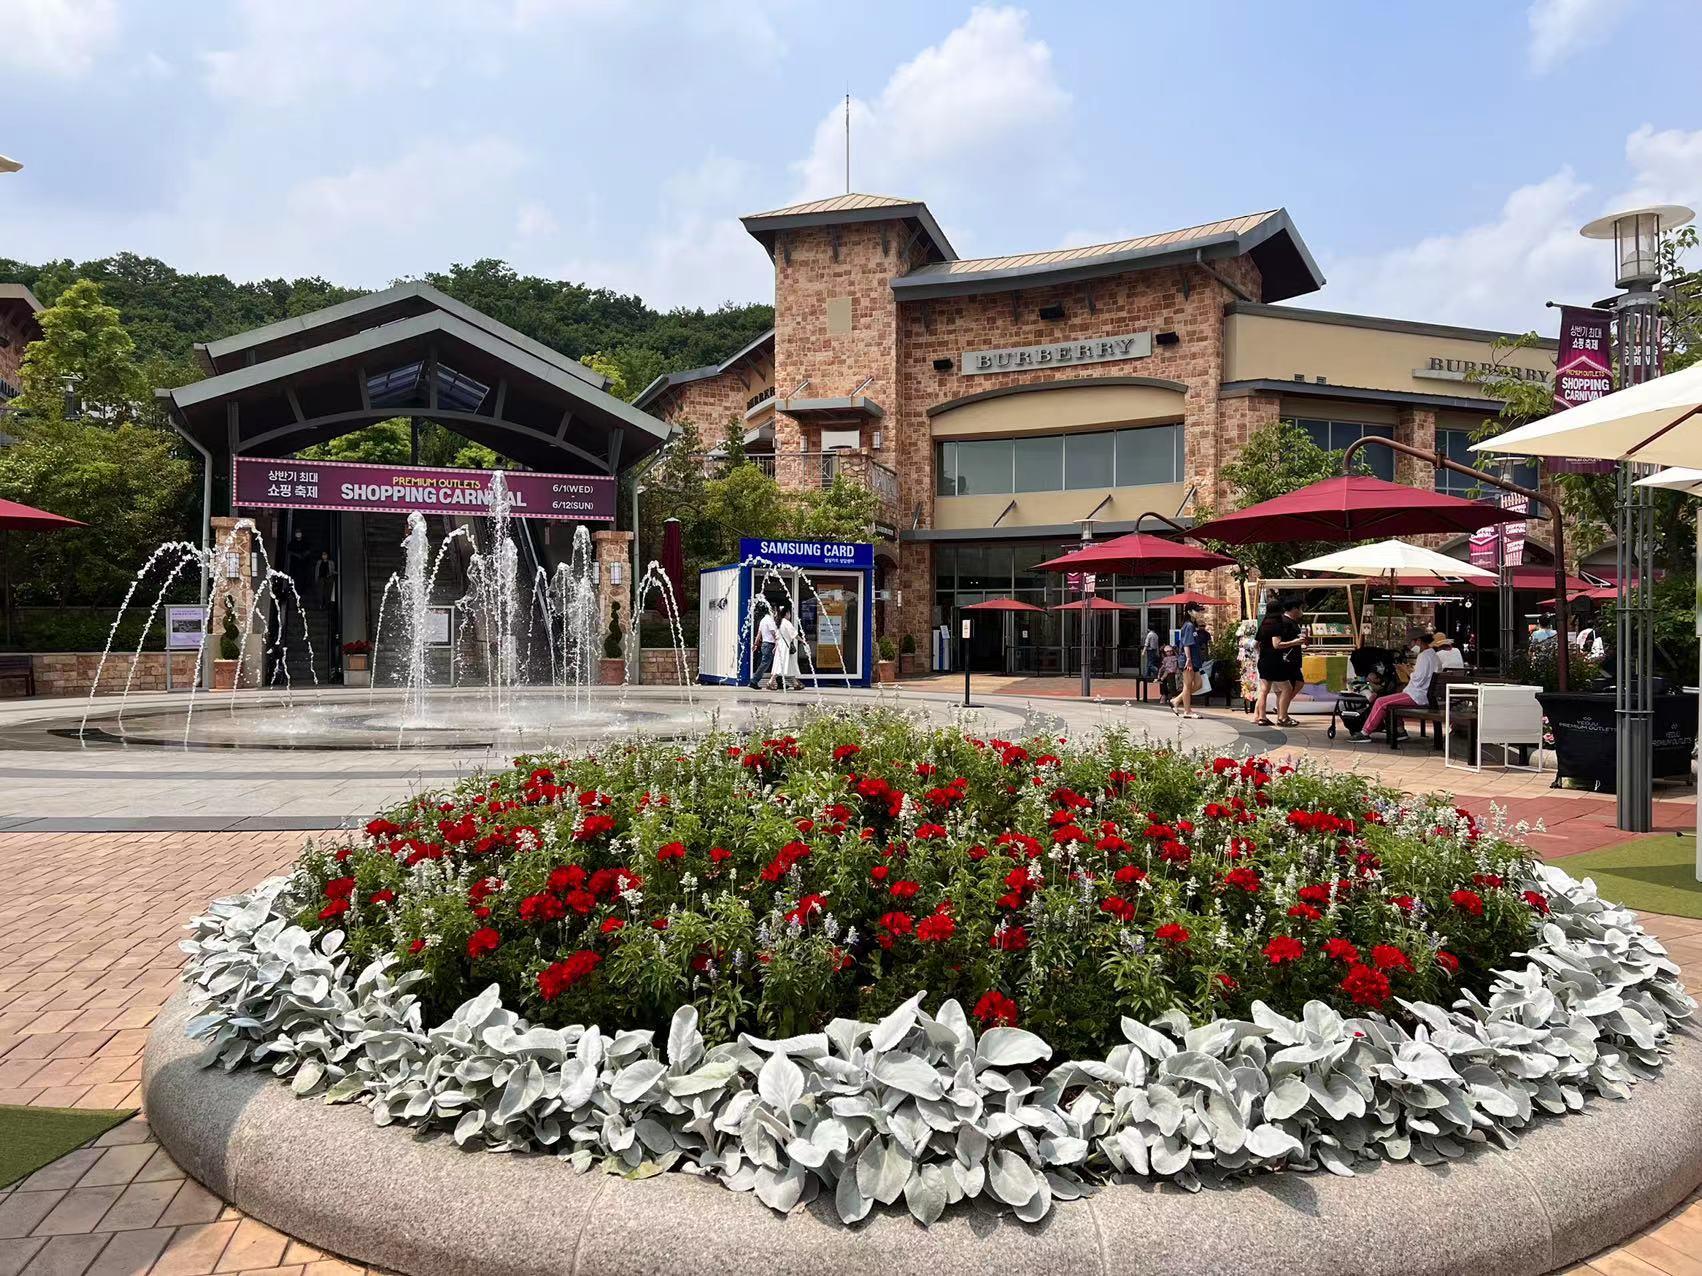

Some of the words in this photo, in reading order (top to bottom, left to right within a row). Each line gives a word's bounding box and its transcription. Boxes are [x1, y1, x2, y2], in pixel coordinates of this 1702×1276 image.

[976, 338, 1135, 369] BURBERRY
[1561, 376, 1610, 391] SHOPPING
[268, 470, 297, 482] 상반기
[299, 471, 319, 483] 최대
[392, 476, 437, 488] PREMIUM
[438, 478, 481, 489] OUTLETS
[267, 484, 292, 498] 쇼핑
[294, 485, 318, 499] 축제
[341, 483, 436, 503] SHOPPING
[438, 487, 527, 507] CARNIAL
[552, 484, 594, 493] 6/1(WED)
[552, 501, 594, 510] 6/12(SUN)
[760, 541, 821, 555] SAMSUNG
[823, 544, 855, 557] CARD
